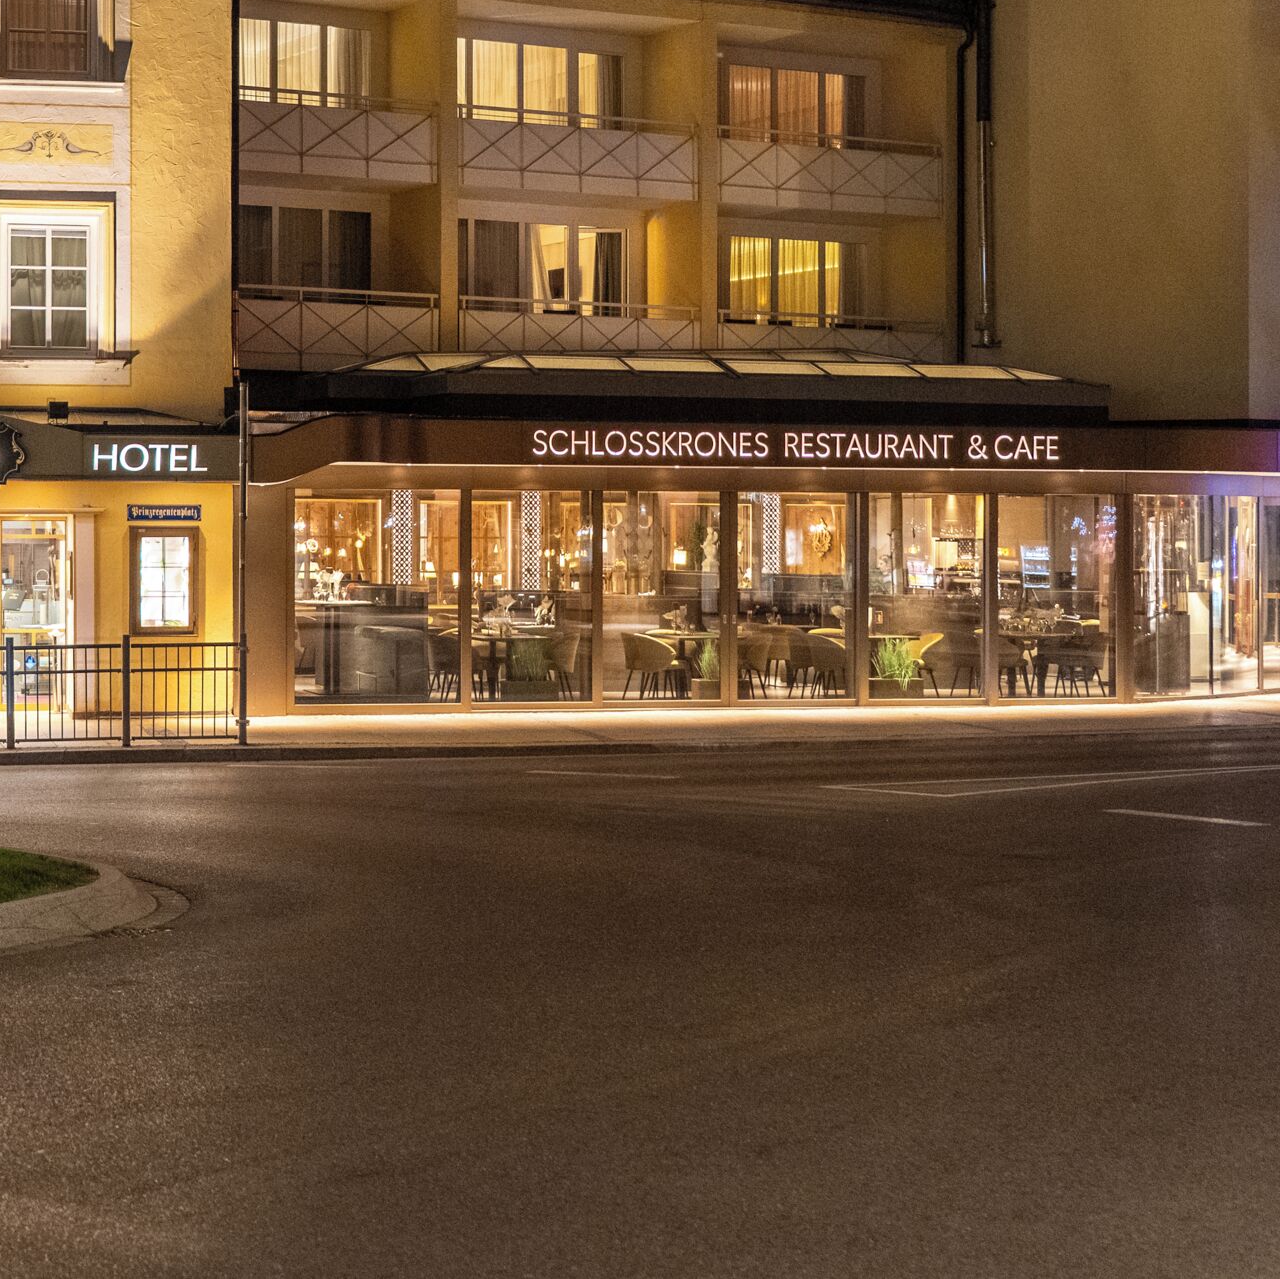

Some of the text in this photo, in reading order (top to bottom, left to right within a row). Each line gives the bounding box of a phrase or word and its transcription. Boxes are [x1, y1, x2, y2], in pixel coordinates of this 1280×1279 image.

[92, 443, 208, 472] HOTEL
[532, 429, 1060, 461] SCHLOSSKRONES RESTAURANT & CAFE
[131, 506, 198, 519] Prinzregentenplatz
